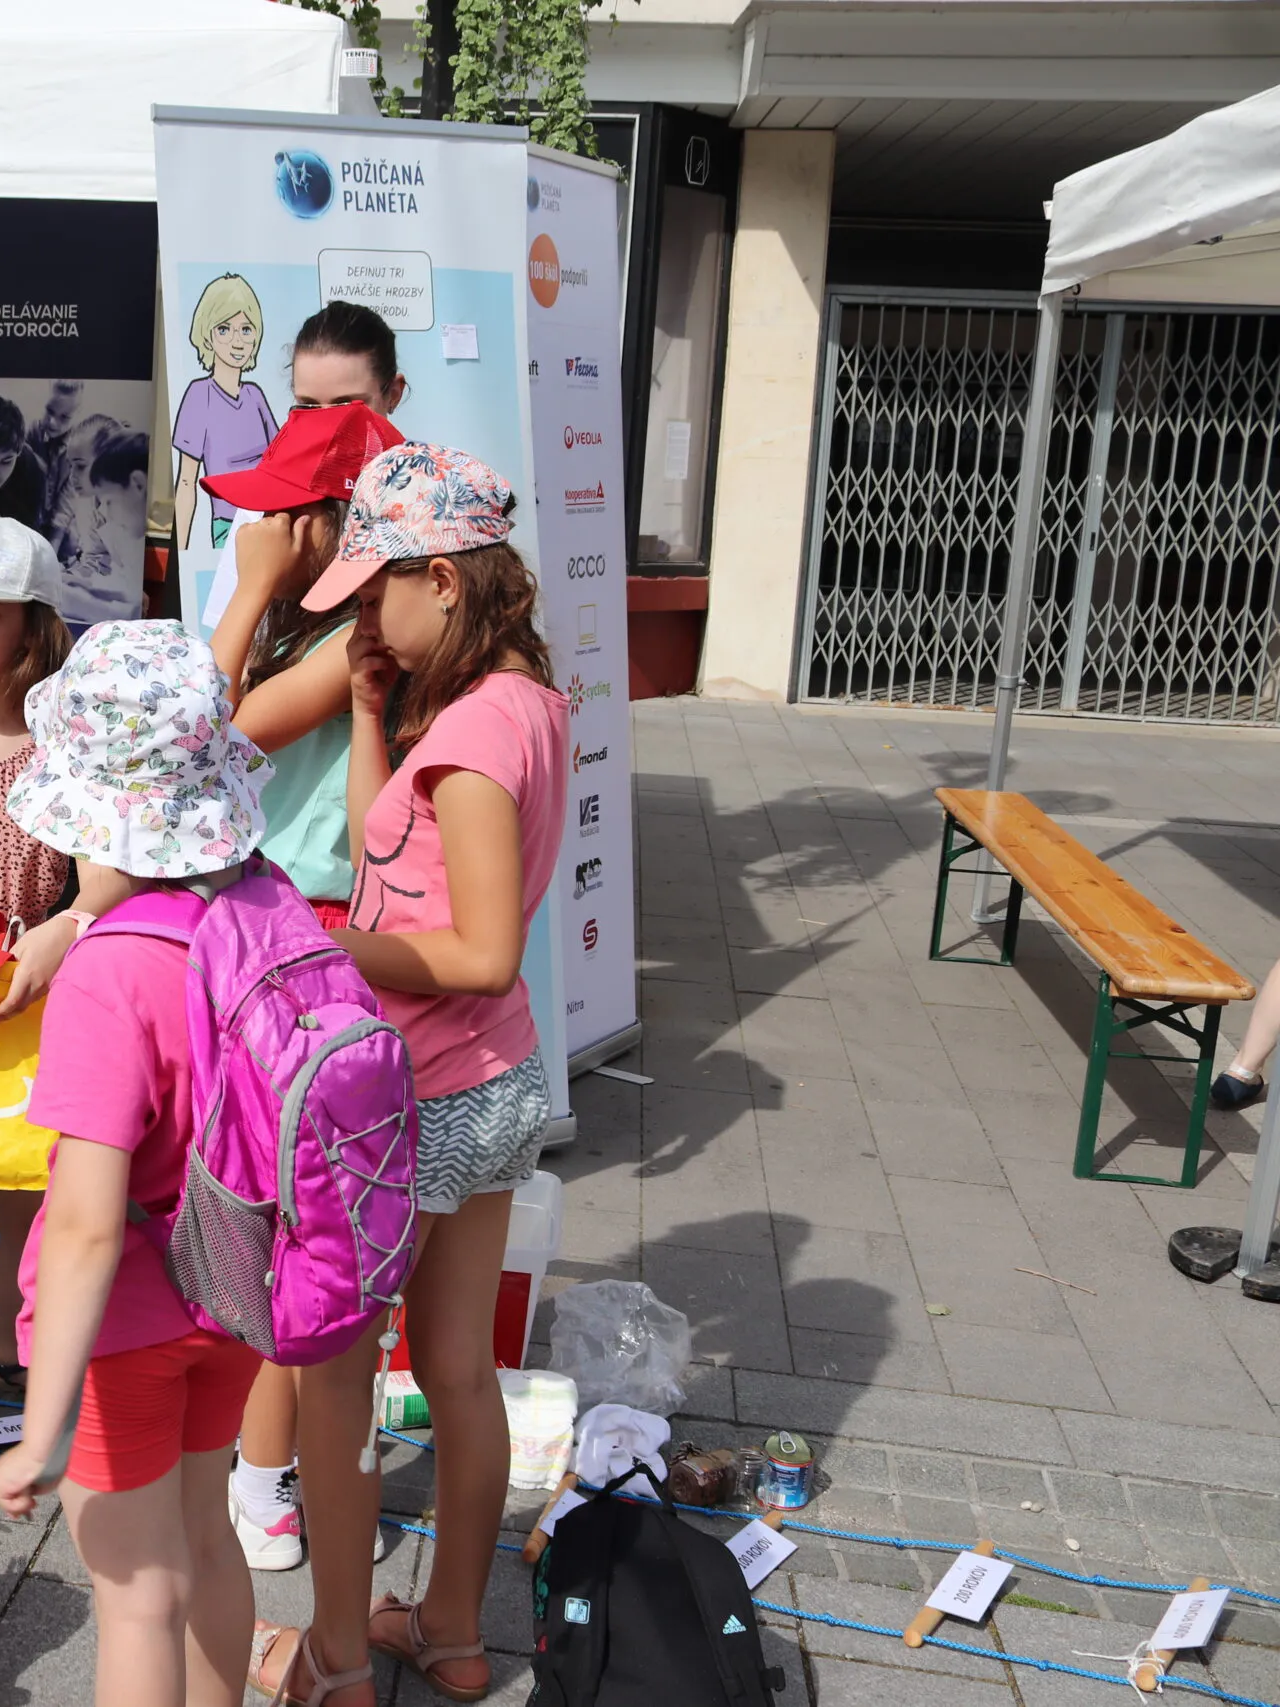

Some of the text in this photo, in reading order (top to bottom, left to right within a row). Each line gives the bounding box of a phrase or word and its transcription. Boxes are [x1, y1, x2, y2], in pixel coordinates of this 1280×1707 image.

[341, 158, 424, 186] POŽIČANÁ
[343, 188, 418, 213] PLANÉTA
[347, 266, 405, 279] DEFINUJ TRI
[529, 261, 545, 280] 100
[385, 286, 424, 298] HROZBY
[575, 432, 602, 445] VEOLIA
[567, 554, 605, 579] ecco
[579, 746, 608, 767] mondi
[567, 1000, 585, 1016] Nitra
[747, 1536, 773, 1561] ROKOV
[964, 1565, 988, 1591] ROKOV
